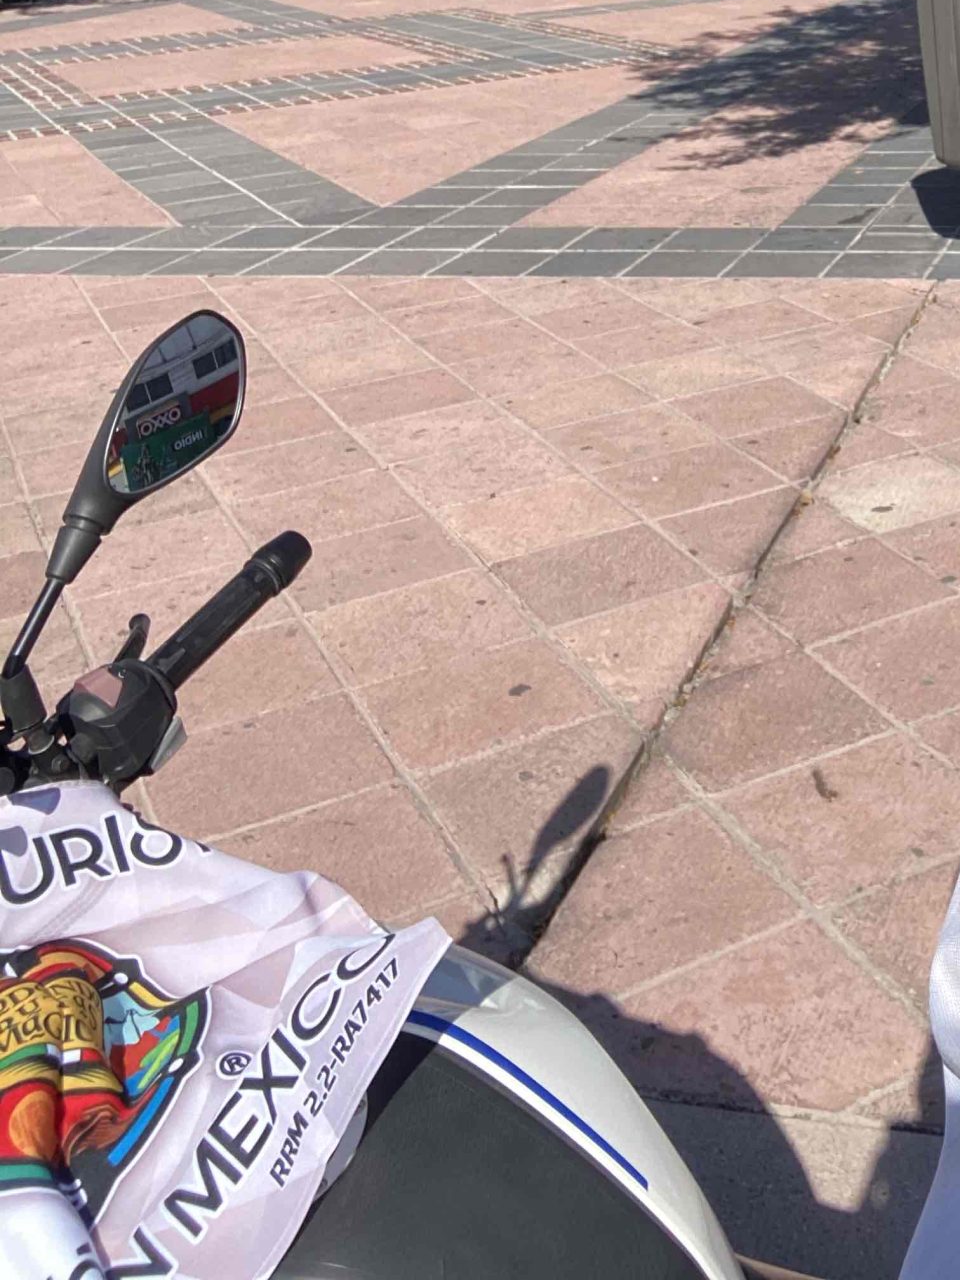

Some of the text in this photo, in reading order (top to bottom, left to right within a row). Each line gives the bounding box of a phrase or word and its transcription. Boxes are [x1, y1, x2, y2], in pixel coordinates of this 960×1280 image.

[164, 933, 396, 1238] MEXICO
[269, 958, 398, 1187] RRM 2.2-RA7417
